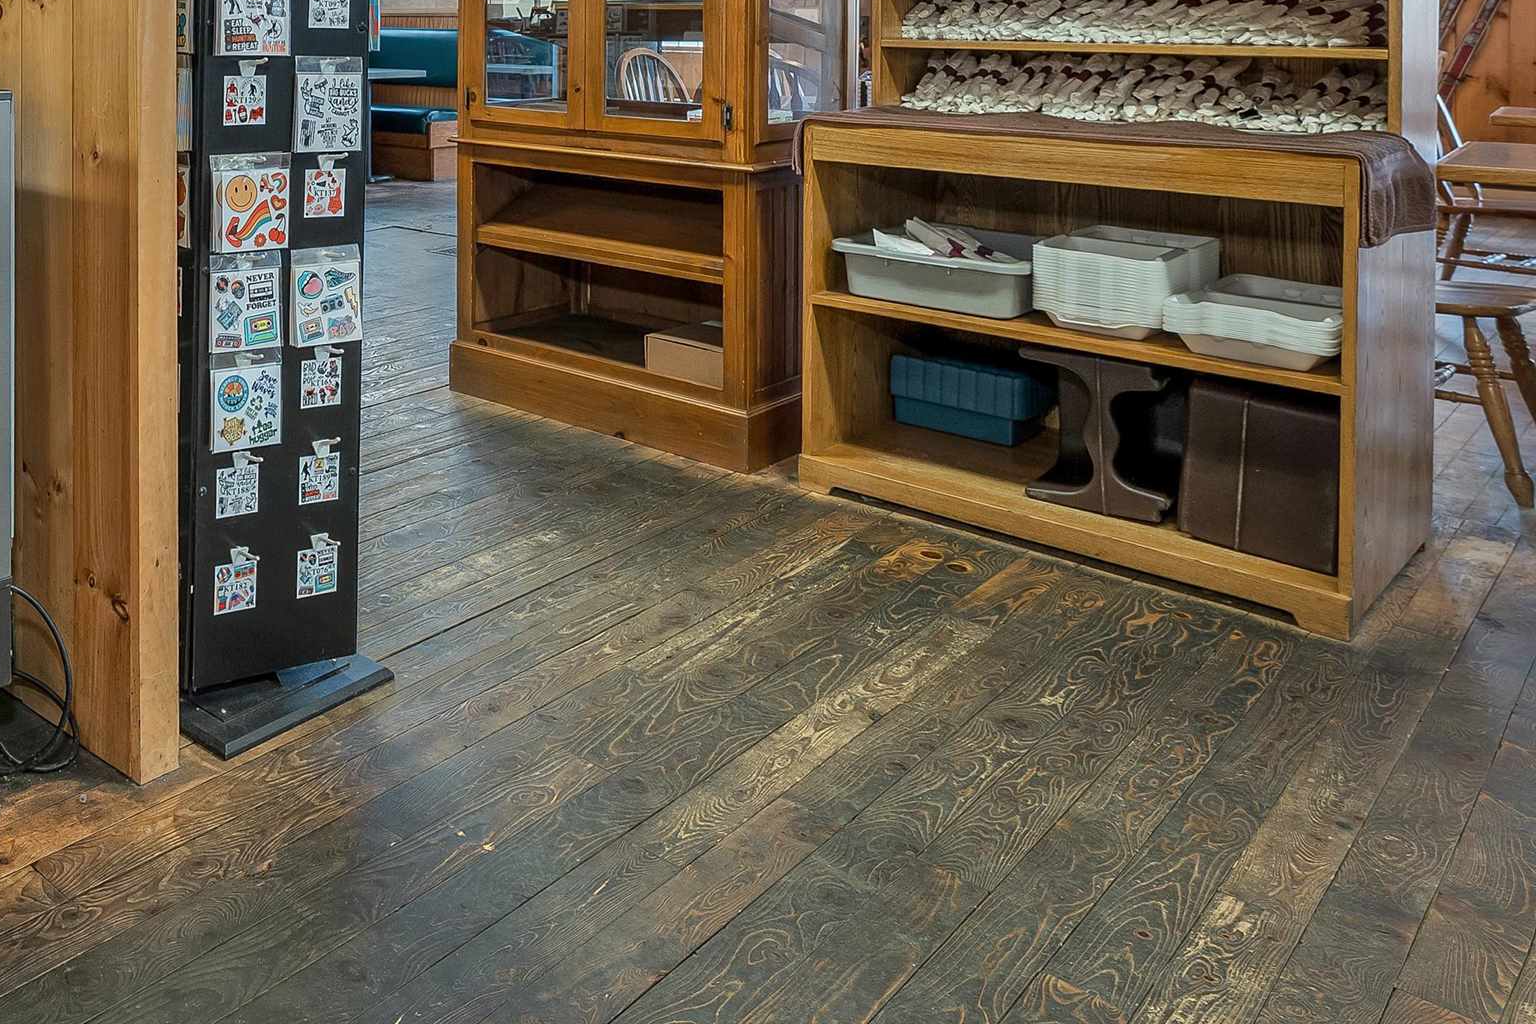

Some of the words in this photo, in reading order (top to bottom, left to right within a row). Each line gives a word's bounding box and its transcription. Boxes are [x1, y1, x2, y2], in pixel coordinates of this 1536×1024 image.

[231, 18, 244, 27] EAT
[231, 27, 252, 35] SLEEP
[232, 42, 258, 51] REPEAT
[246, 272, 275, 283] NEVER
[246, 300, 277, 311] FORGET
[258, 370, 278, 384] Save
[251, 381, 275, 399] Waves
[249, 428, 278, 445] hugger
